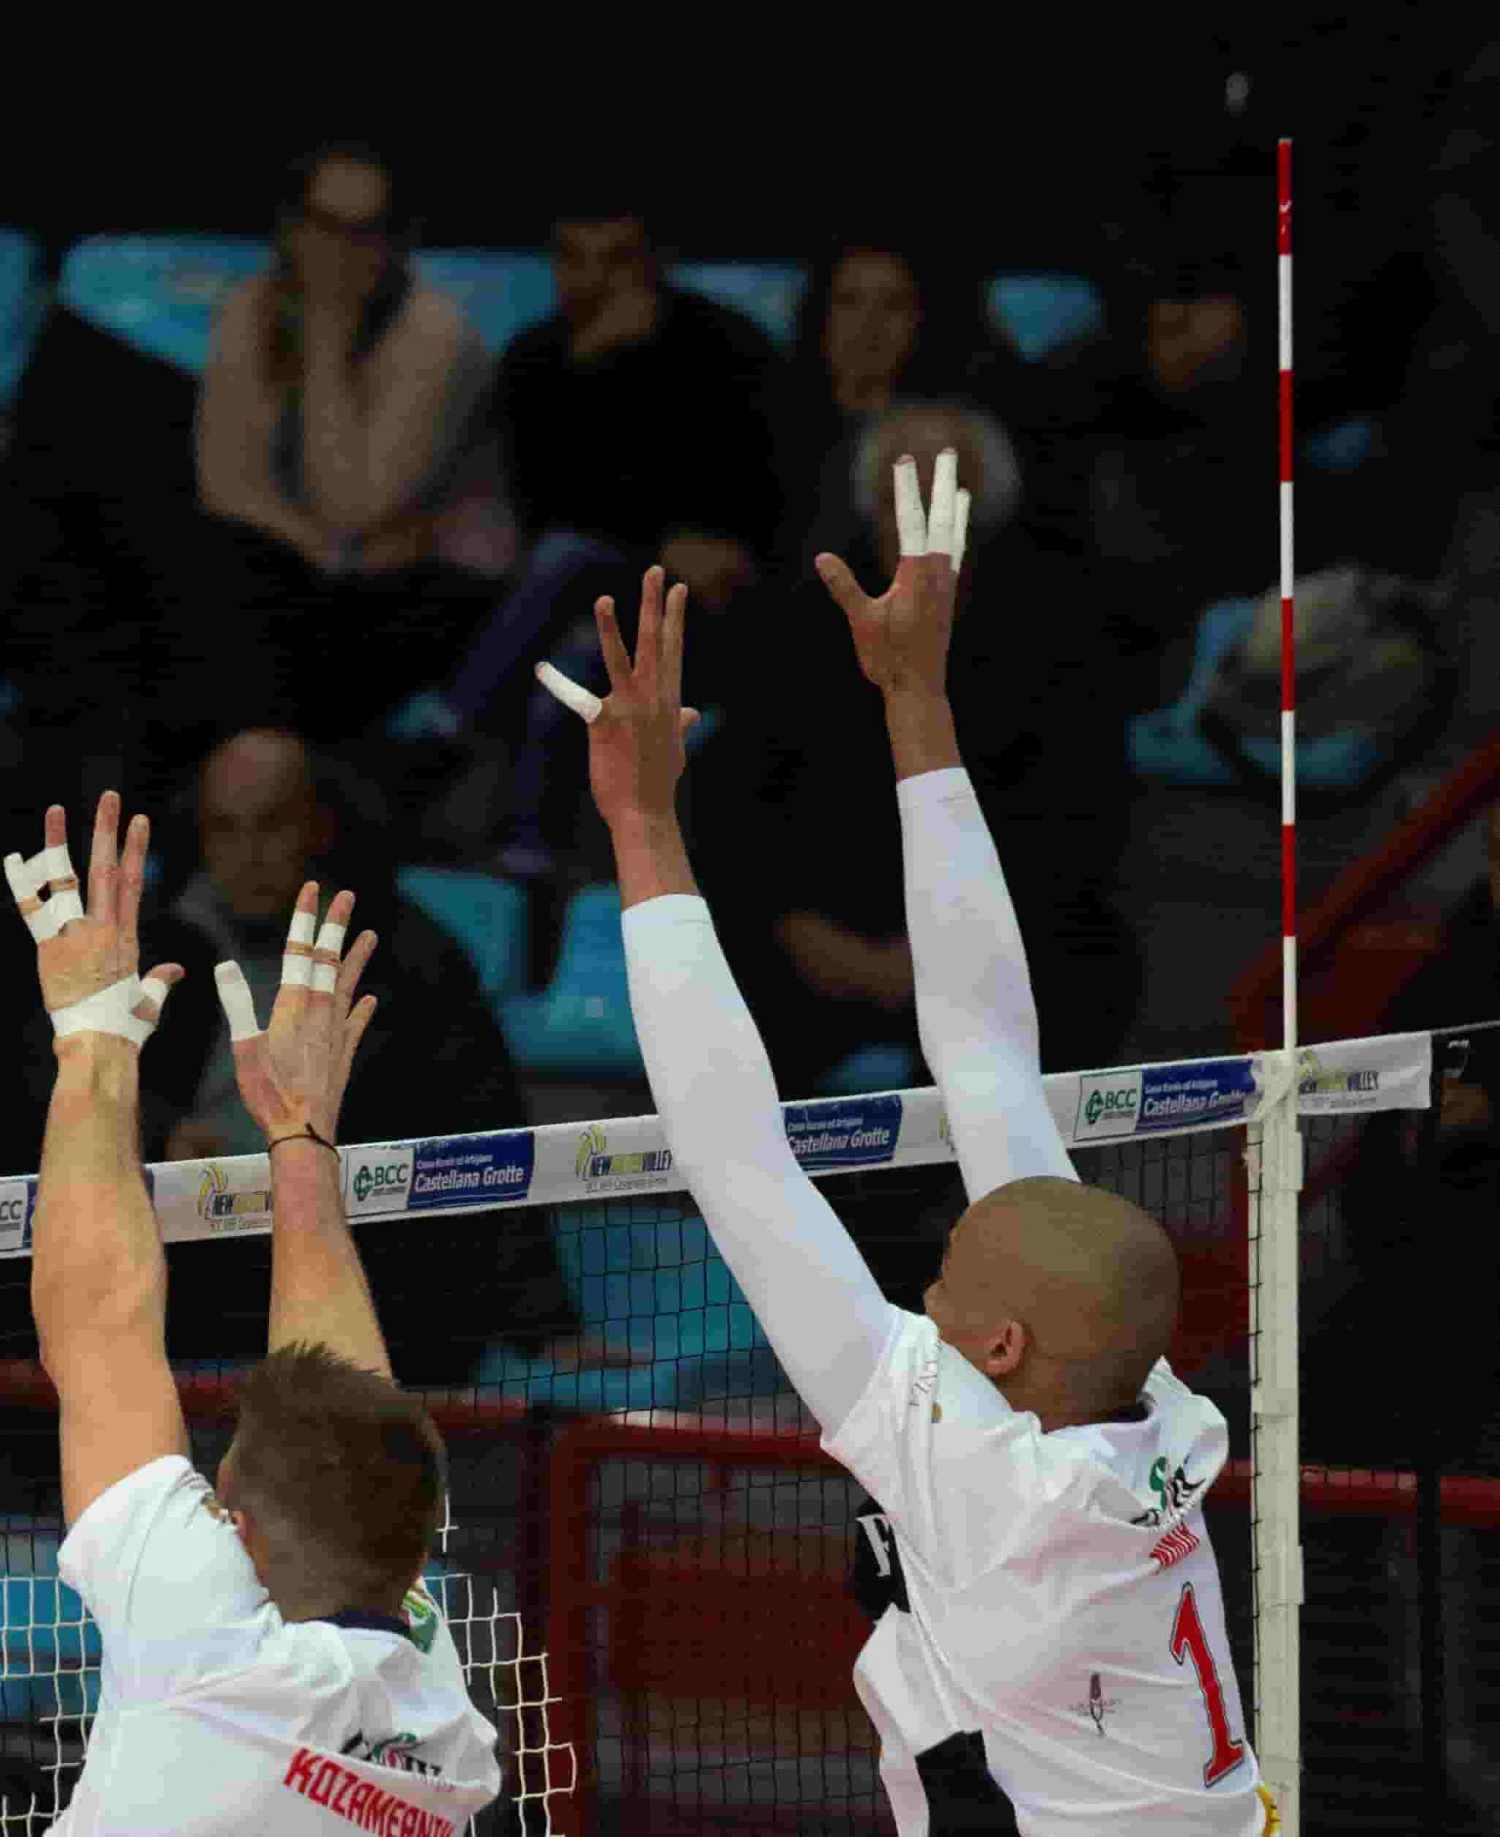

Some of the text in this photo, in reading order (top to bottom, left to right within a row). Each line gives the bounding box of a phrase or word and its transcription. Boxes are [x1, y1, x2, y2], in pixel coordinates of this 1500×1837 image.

[1105, 1088, 1137, 1110] BCC
[1143, 1094, 1207, 1117] Castellana
[788, 1127, 891, 1156] Castellana Grotte
[374, 1163, 410, 1186] BCC
[414, 1171, 480, 1194] Castellana
[483, 1165, 525, 1187] Grotte
[1168, 1580, 1246, 1790] 1
